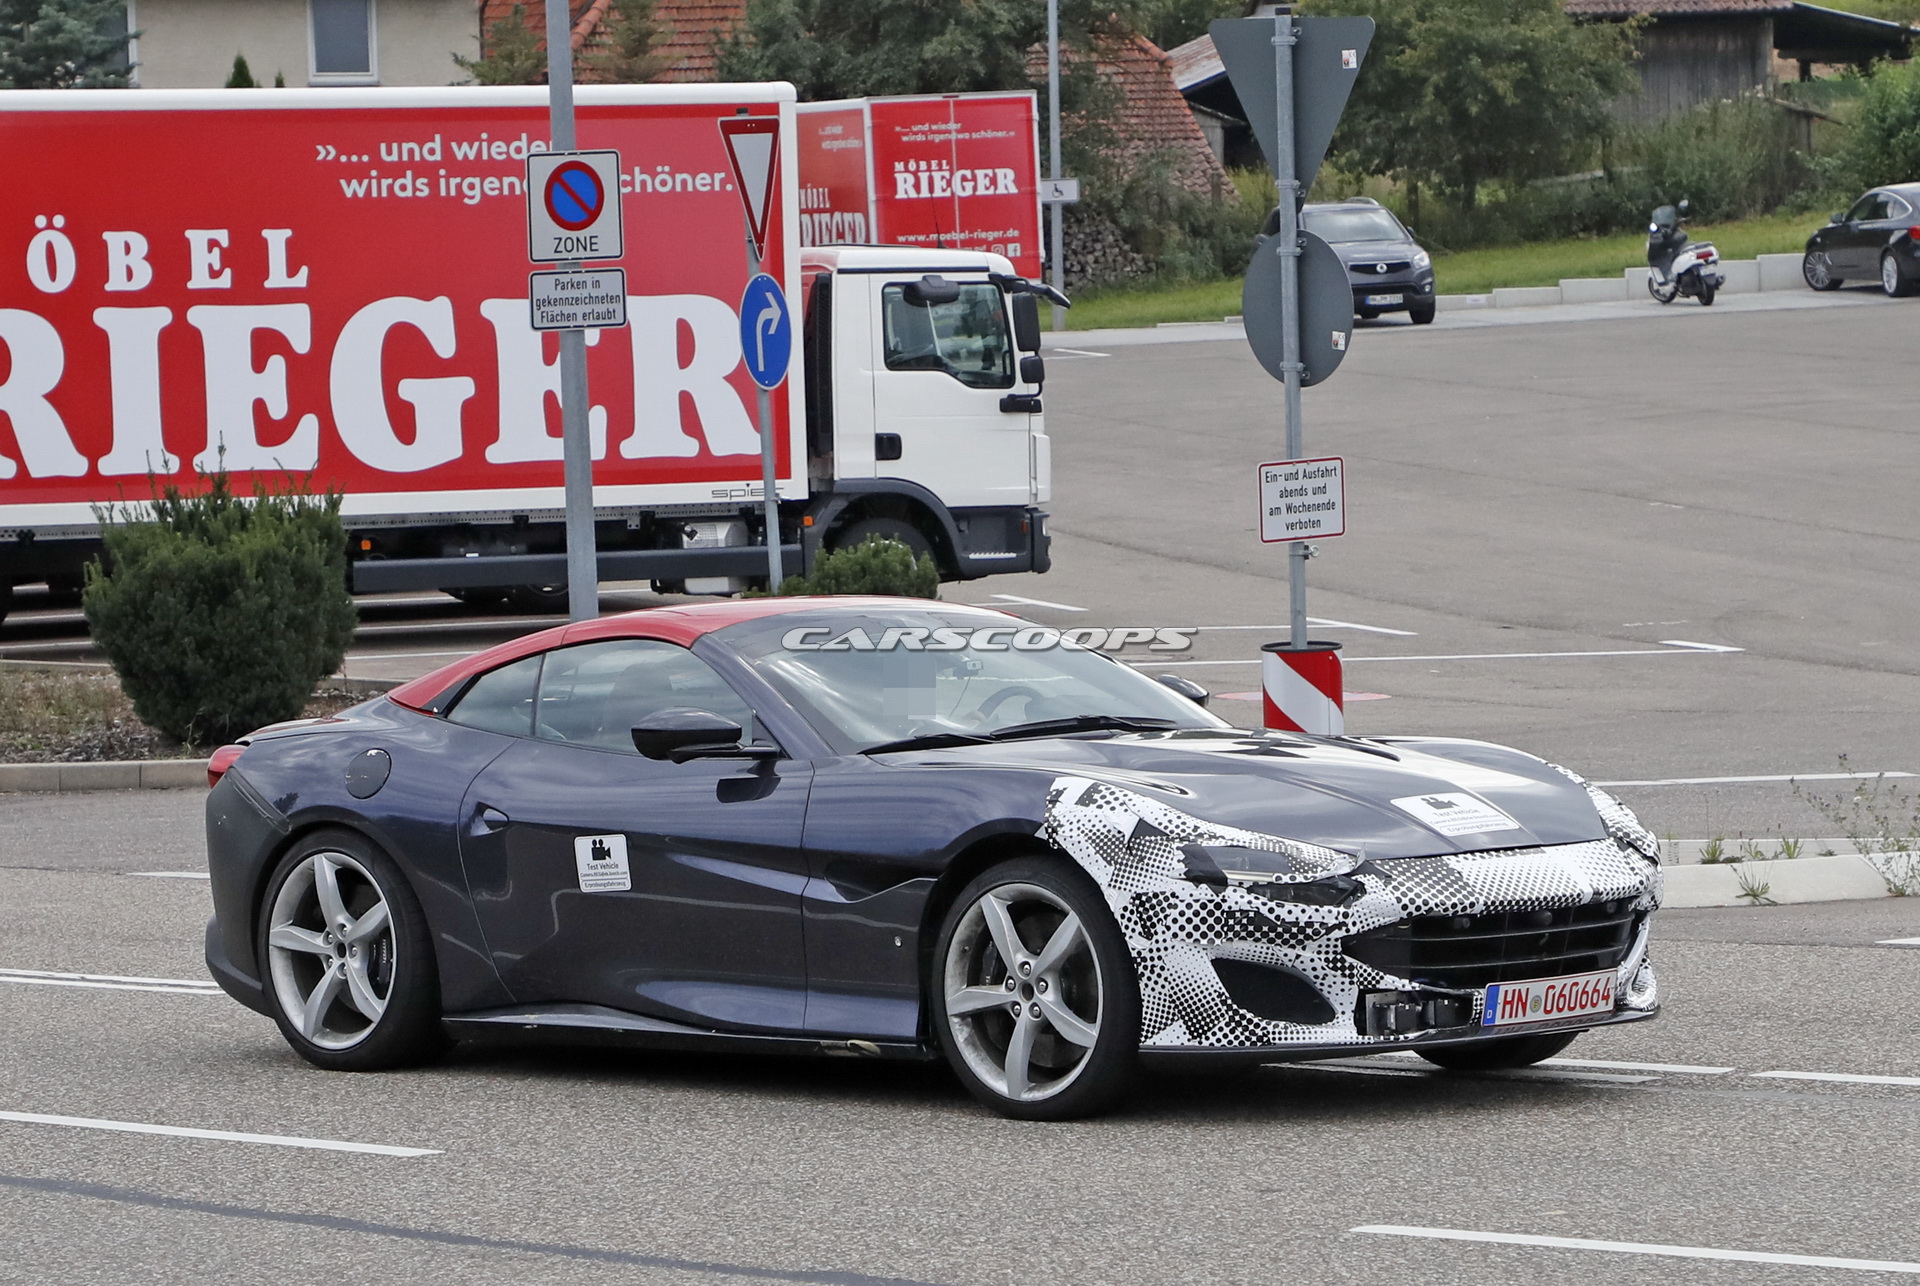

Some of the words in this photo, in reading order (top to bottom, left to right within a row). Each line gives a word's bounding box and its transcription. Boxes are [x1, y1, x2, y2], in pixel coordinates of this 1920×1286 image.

[911, 123, 929, 131] und
[931, 122, 961, 131] wieder
[901, 133, 926, 142] wirds
[928, 132, 970, 142] irgendwo
[380, 133, 442, 161] und
[450, 132, 552, 160] wiede
[894, 159, 950, 172] MÖBEL
[339, 169, 430, 198] wirds
[620, 165, 733, 193] chöner.
[894, 168, 1018, 199] RIEGER
[897, 228, 1019, 242] www.moebel-rieger.de
[553, 235, 599, 254] ZONE
[554, 278, 587, 291] Parken
[591, 276, 600, 289] in
[535, 293, 621, 310] gekennzeichneten
[540, 310, 577, 323] Flächen
[582, 308, 617, 321] erlaubt
[1284, 469, 1299, 481] und
[1302, 466, 1337, 480] Ausfahrt
[712, 483, 784, 500] spie
[1279, 485, 1308, 498] abends
[1312, 483, 1327, 495] und
[1269, 506, 1281, 516] am
[1285, 499, 1336, 514] Wochenende
[1285, 518, 1321, 531] verboten
[599, 862, 619, 870] Vehicle
[1502, 988, 1529, 1018] HN
[1544, 977, 1610, 1013] 060664
[1486, 1009, 1493, 1019] D
